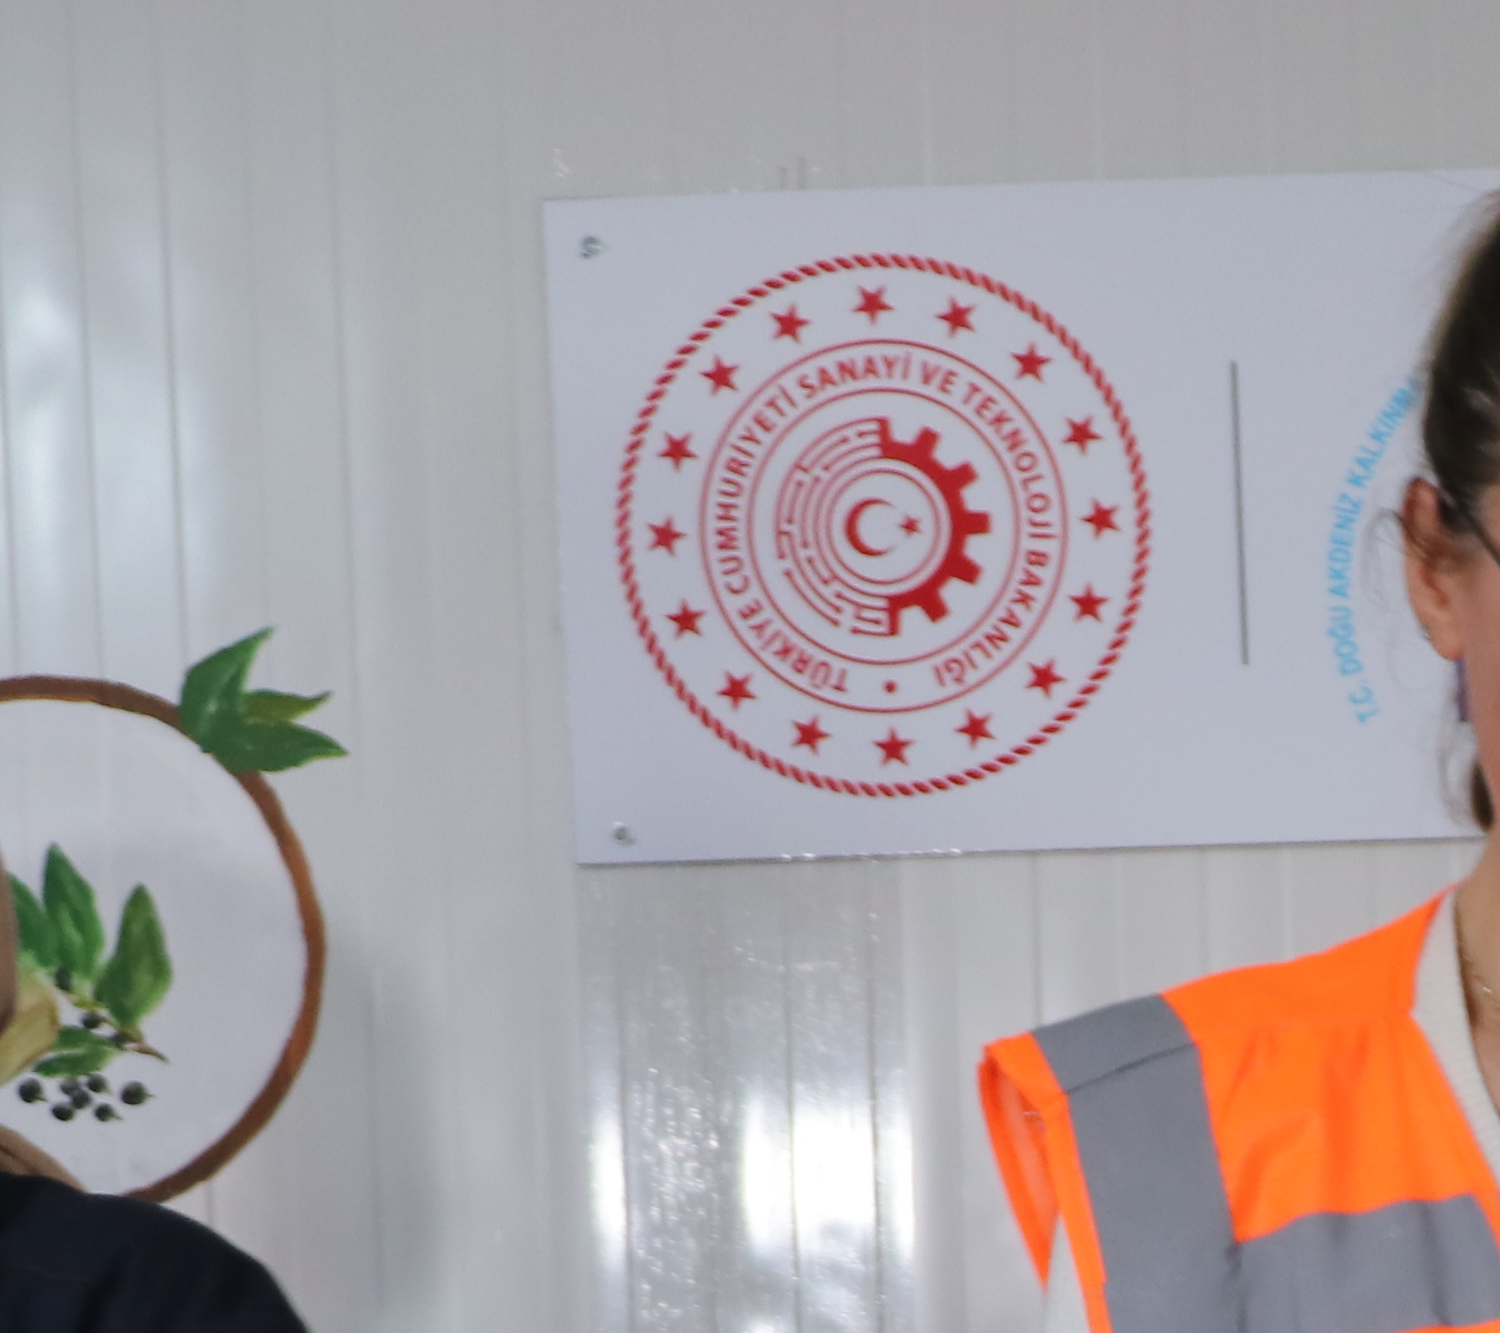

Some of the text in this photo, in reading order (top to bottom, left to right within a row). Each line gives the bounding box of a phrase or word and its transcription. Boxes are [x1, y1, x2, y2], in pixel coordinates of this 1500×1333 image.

[715, 352, 1058, 694] TÜRKİYE CUMHURİYETİ SANAYİ VE TEKNOLOJİ BAKANLIĞI
[1327, 493, 1364, 598] AKDENİZ
[1327, 605, 1364, 675] DOĞU
